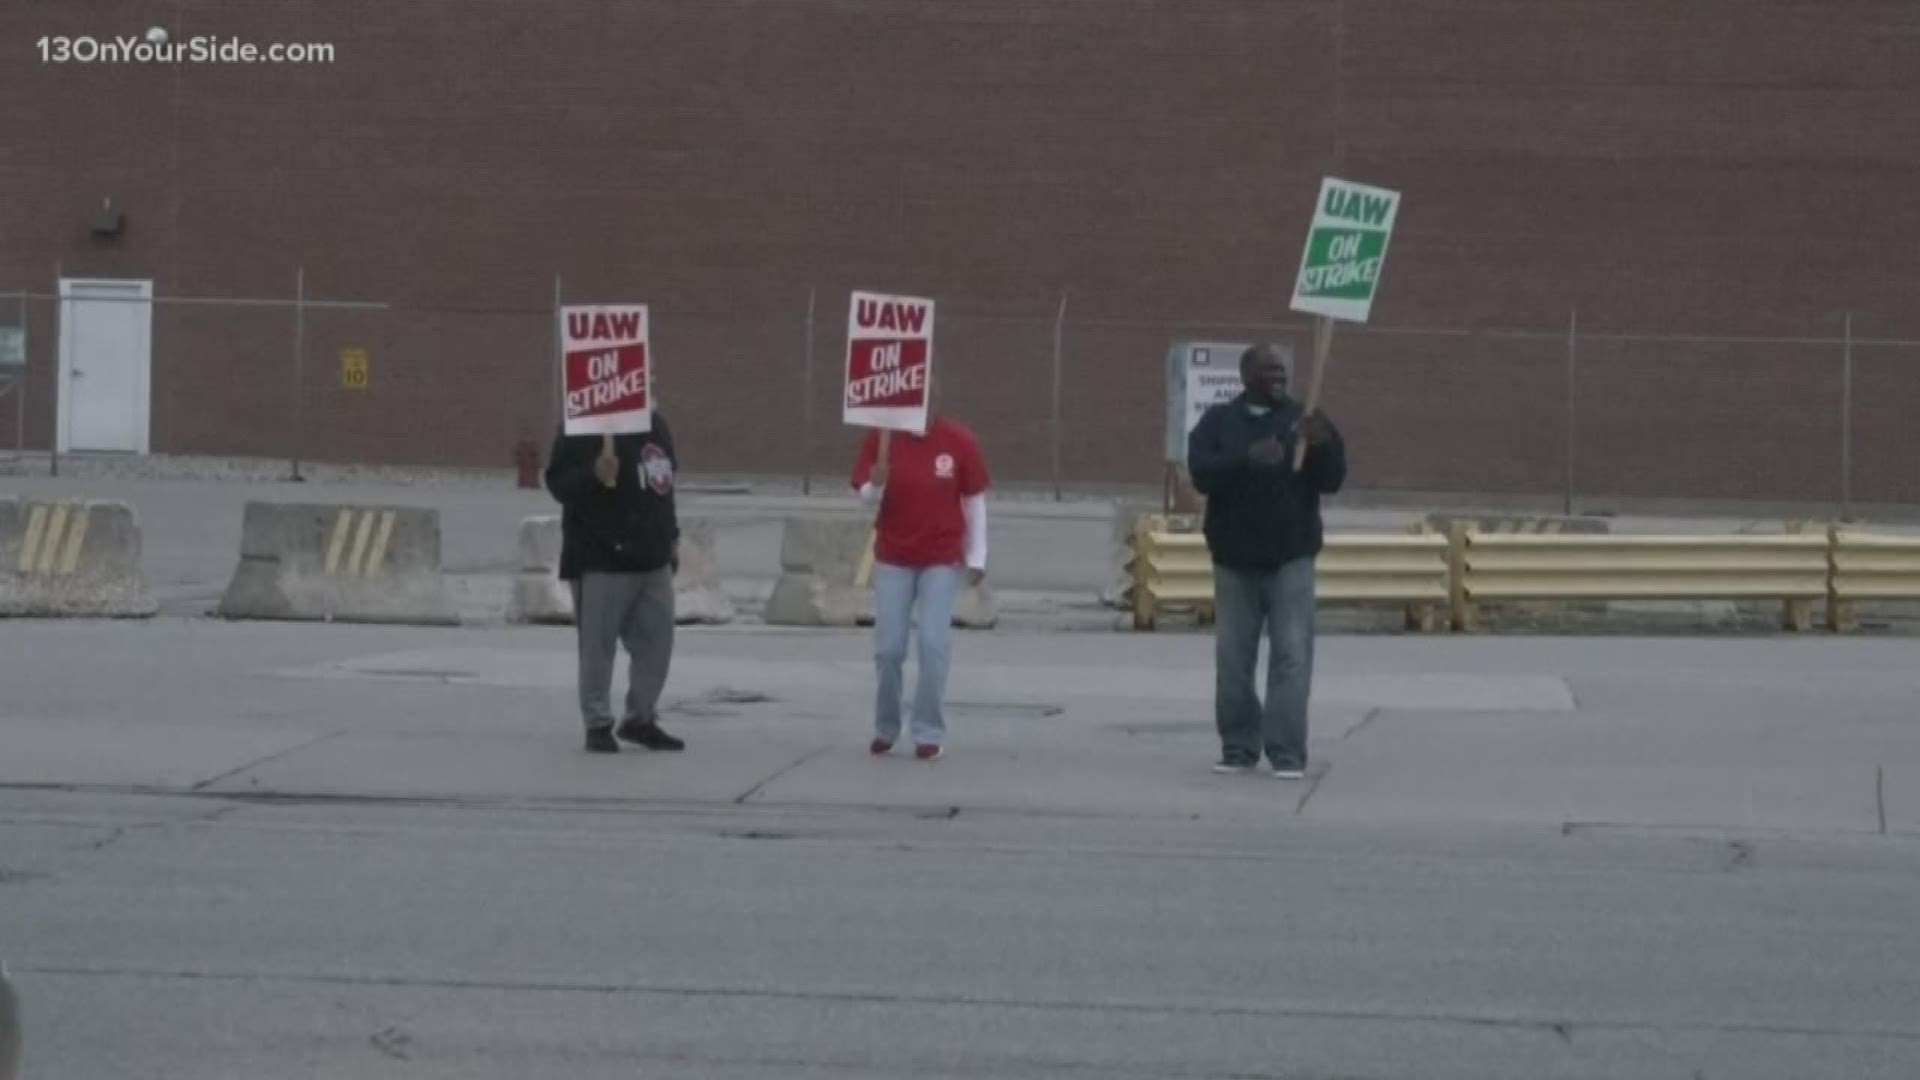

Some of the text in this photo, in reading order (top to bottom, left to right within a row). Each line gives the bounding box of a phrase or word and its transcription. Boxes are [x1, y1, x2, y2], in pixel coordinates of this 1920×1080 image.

[1325, 187, 1392, 226] UAW
[1328, 233, 1362, 261] ON
[1304, 257, 1378, 292] STRIKE
[567, 312, 640, 340] UAW
[857, 299, 926, 333] UAW
[588, 350, 618, 380] ON
[870, 342, 900, 371] ON
[568, 368, 645, 416] STRIKE
[848, 363, 924, 403] STRIKE
